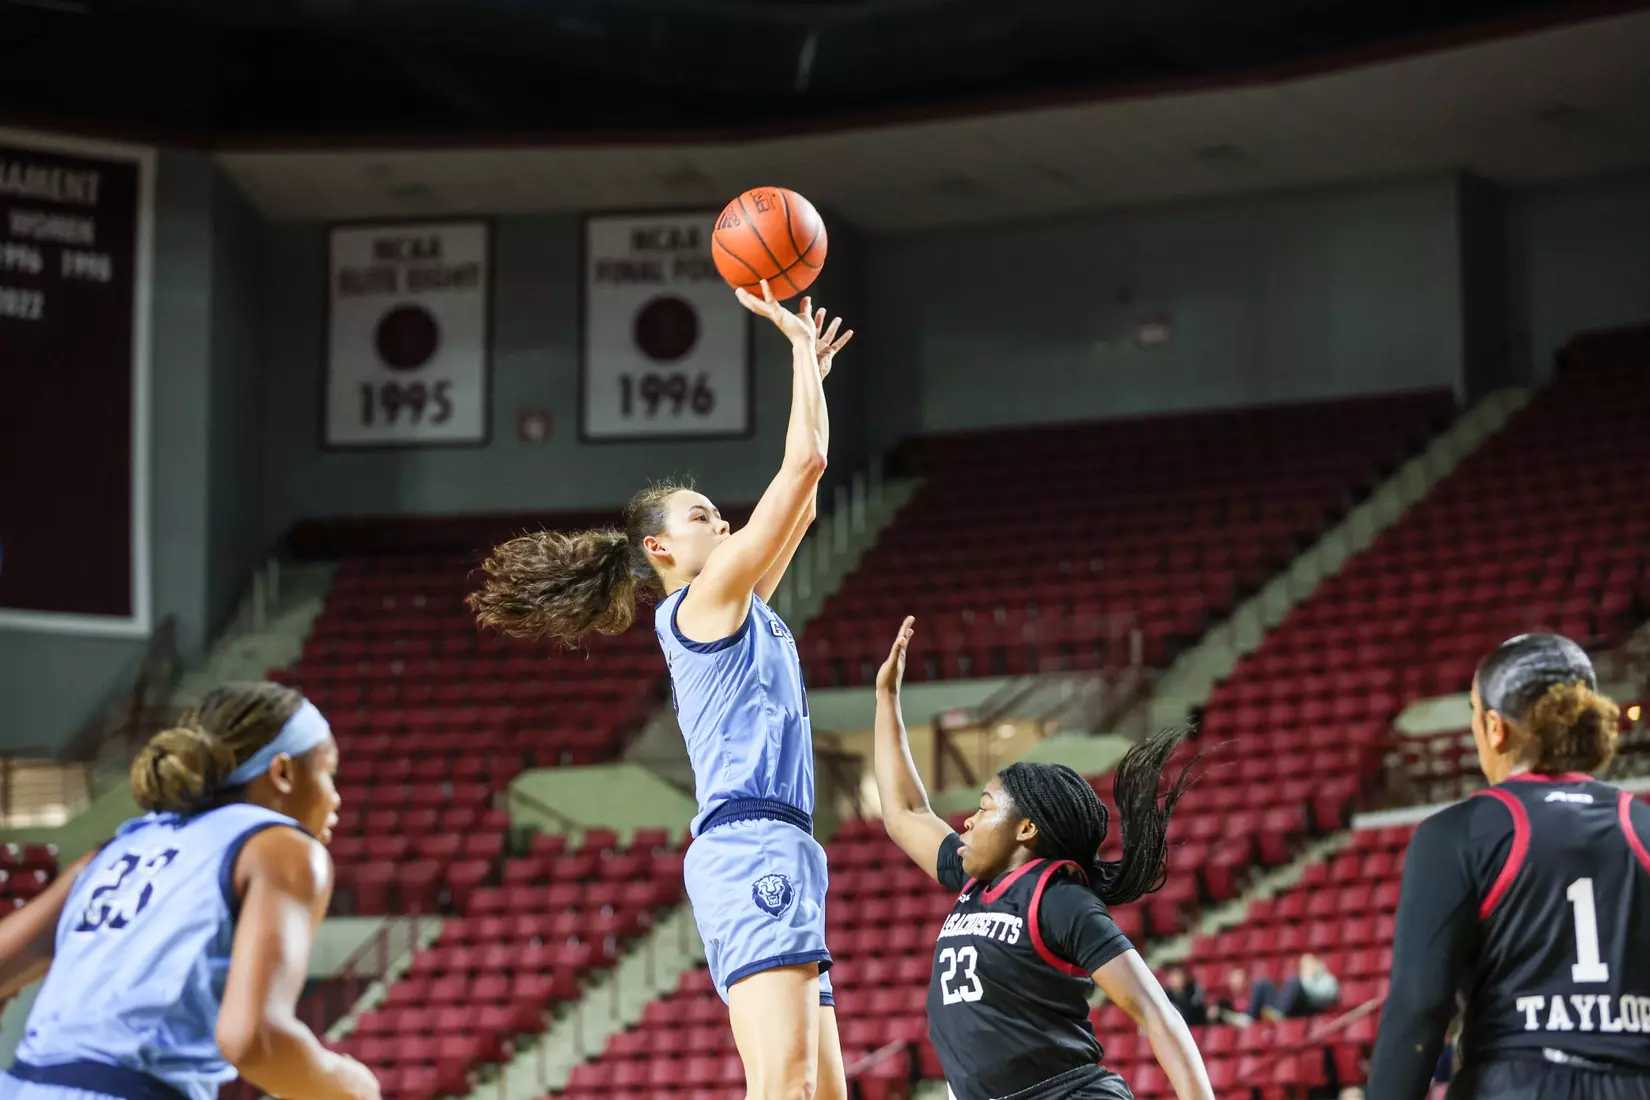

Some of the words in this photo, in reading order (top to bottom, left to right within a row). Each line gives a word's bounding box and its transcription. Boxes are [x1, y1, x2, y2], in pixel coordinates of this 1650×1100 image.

[0, 242, 43, 274] 996
[357, 378, 454, 428] 1995
[618, 371, 717, 420] 1996
[1567, 877, 1609, 982] 1
[939, 946, 984, 1005] 23
